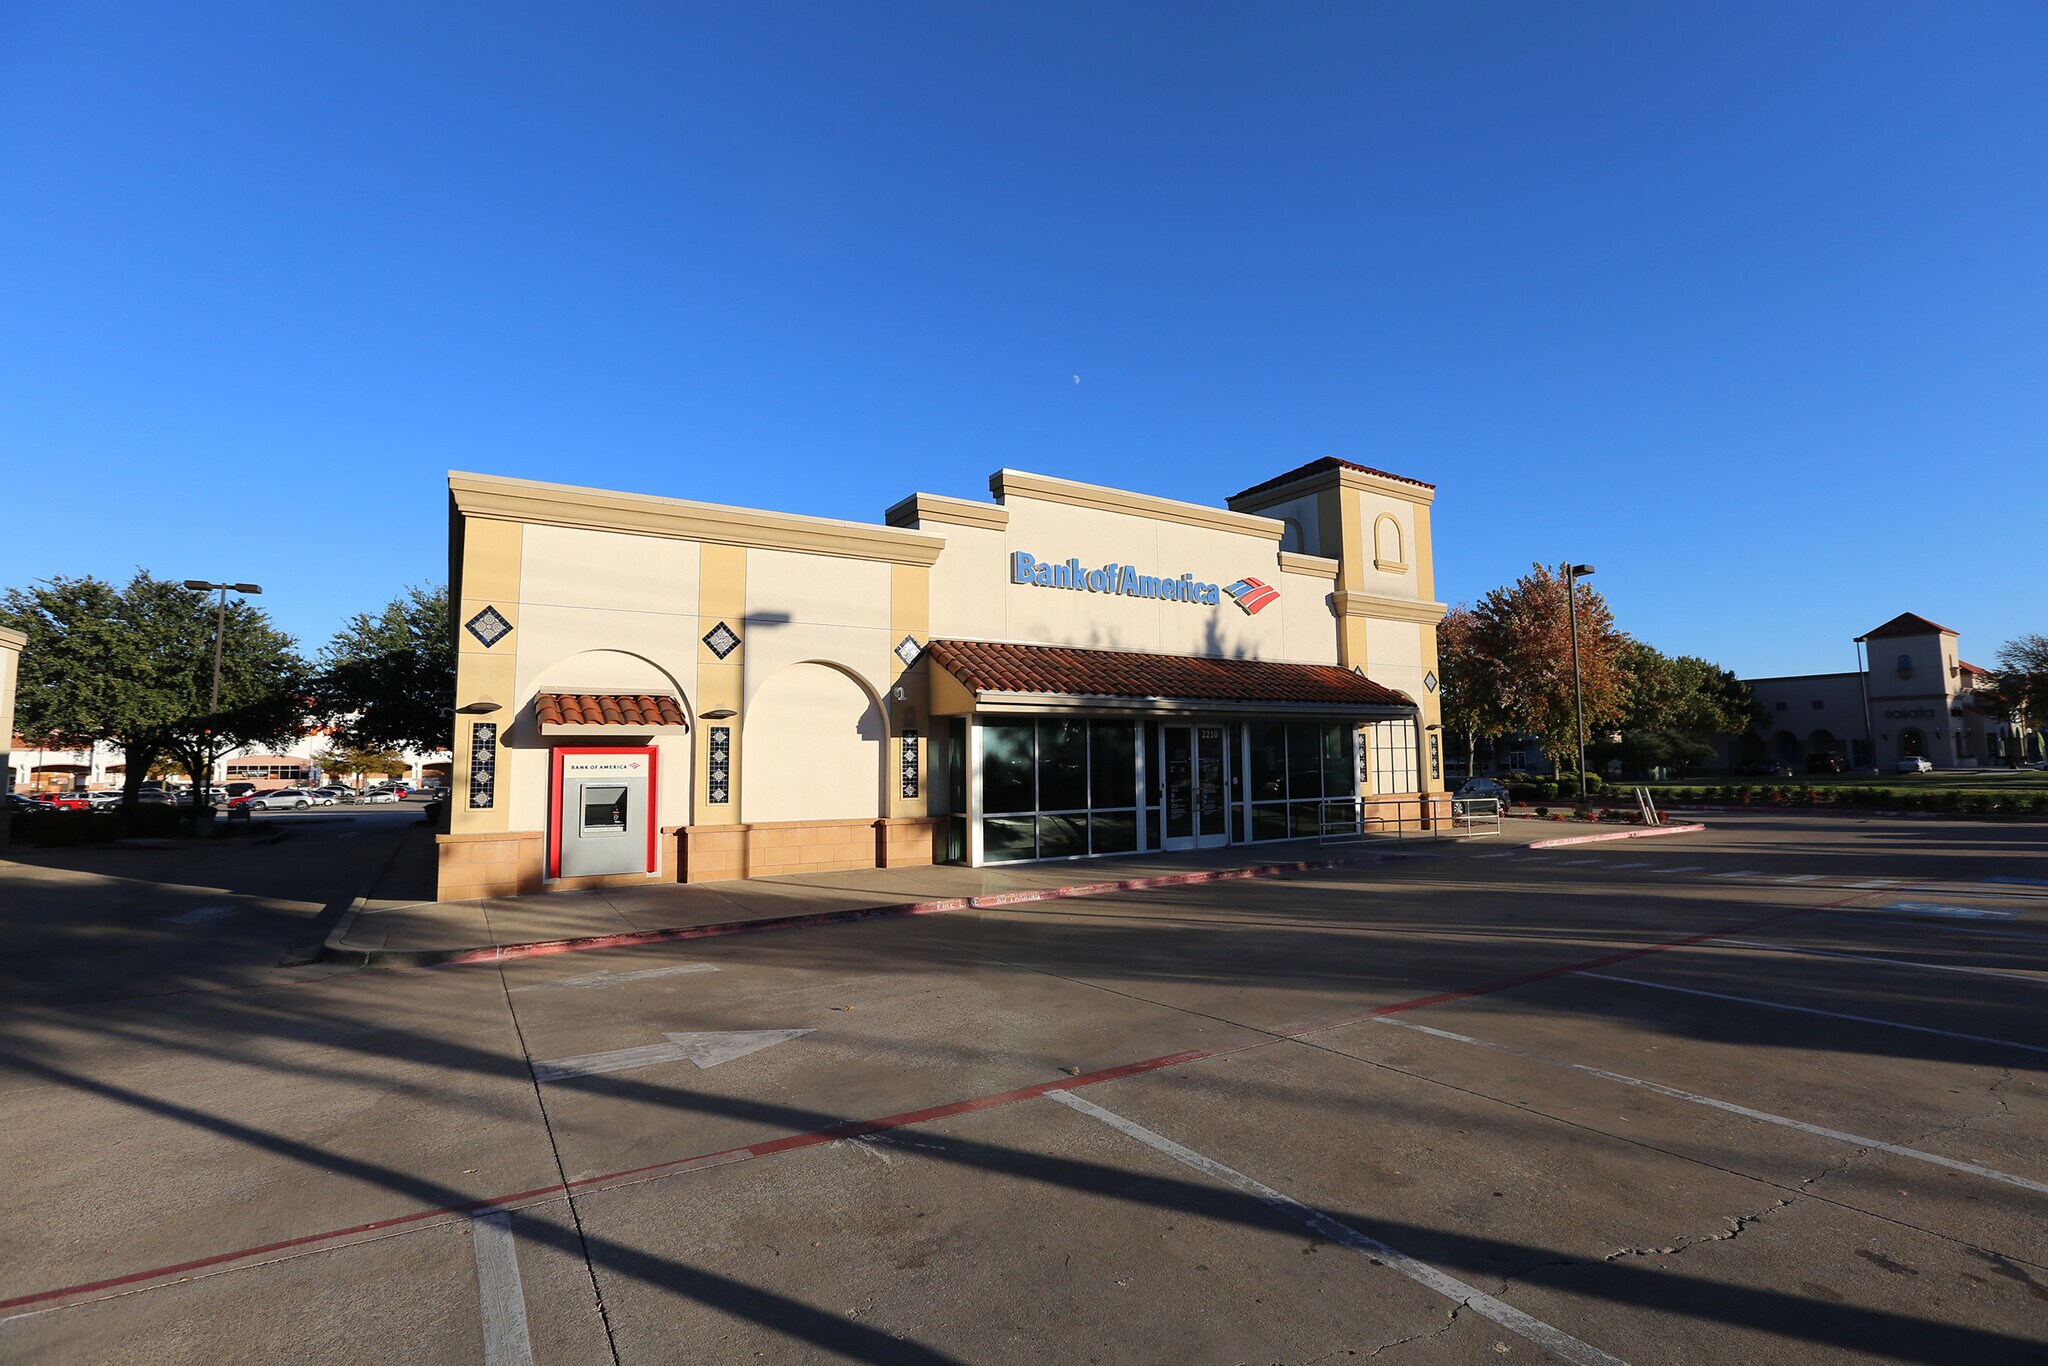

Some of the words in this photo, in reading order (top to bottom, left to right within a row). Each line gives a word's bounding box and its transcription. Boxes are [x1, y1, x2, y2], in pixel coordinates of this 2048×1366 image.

[1011, 551, 1087, 591] Bank
[1087, 563, 1118, 593] of
[1116, 565, 1220, 605] America
[1884, 706, 1935, 719] salata
[1202, 730, 1218, 738] 2210
